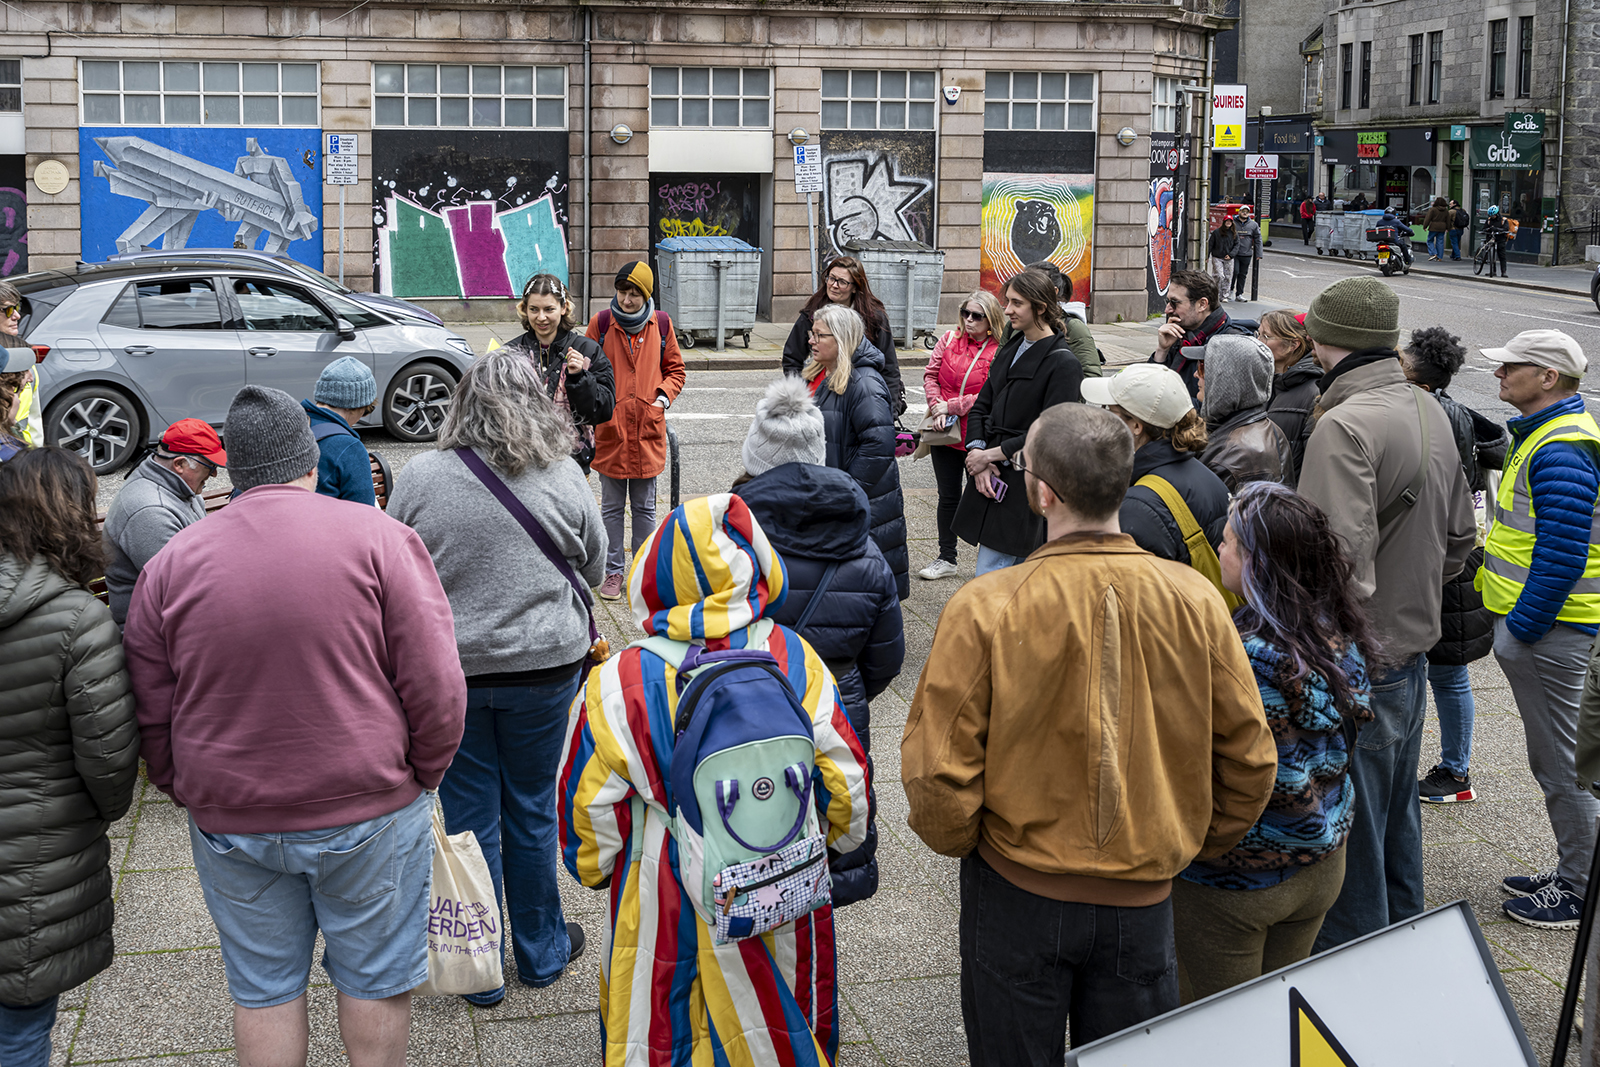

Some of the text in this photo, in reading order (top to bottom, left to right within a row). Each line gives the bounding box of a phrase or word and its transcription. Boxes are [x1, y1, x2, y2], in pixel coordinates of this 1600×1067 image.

[1214, 95, 1244, 108] QUIRIES
[1151, 139, 1175, 148] ontemporar
[1274, 133, 1287, 144] Food
[1357, 132, 1387, 144] FRESH
[1170, 155, 1177, 164] 20
[428, 915, 497, 941] ERDEN
[429, 940, 438, 952] IS
[440, 944, 452, 952] IN
